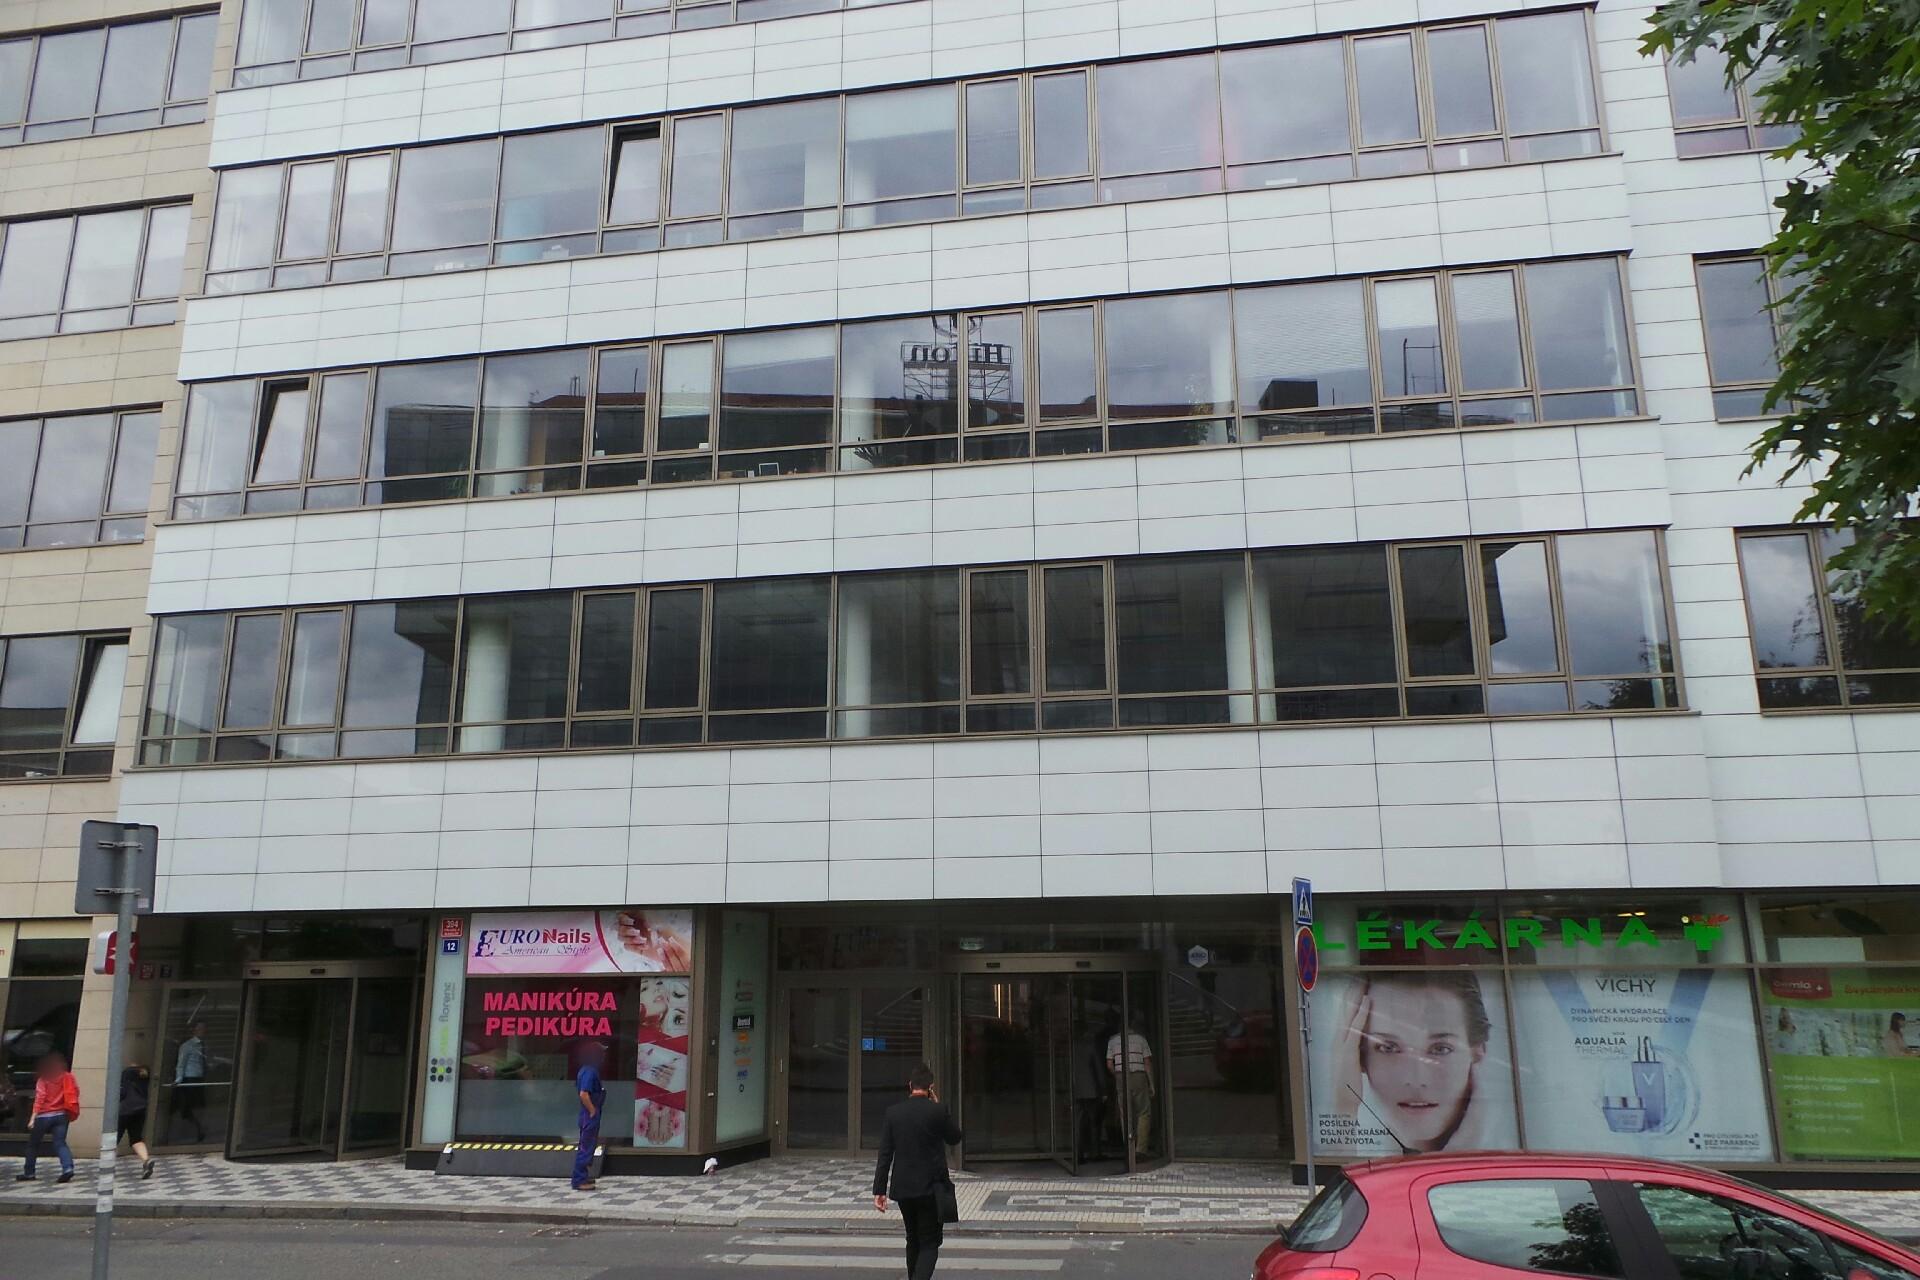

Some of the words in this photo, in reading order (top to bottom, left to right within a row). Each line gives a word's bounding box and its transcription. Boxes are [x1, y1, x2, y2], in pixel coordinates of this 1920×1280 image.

[542, 929, 591, 944] Nails
[1313, 911, 1661, 950] LÉKÁRNA
[447, 942, 456, 951] 12
[1595, 979, 1656, 993] VICHY
[483, 987, 617, 1011] MANIKÚRA
[485, 1012, 612, 1036] PEDIKÚRA
[1574, 1037, 1627, 1045] AQUALIA
